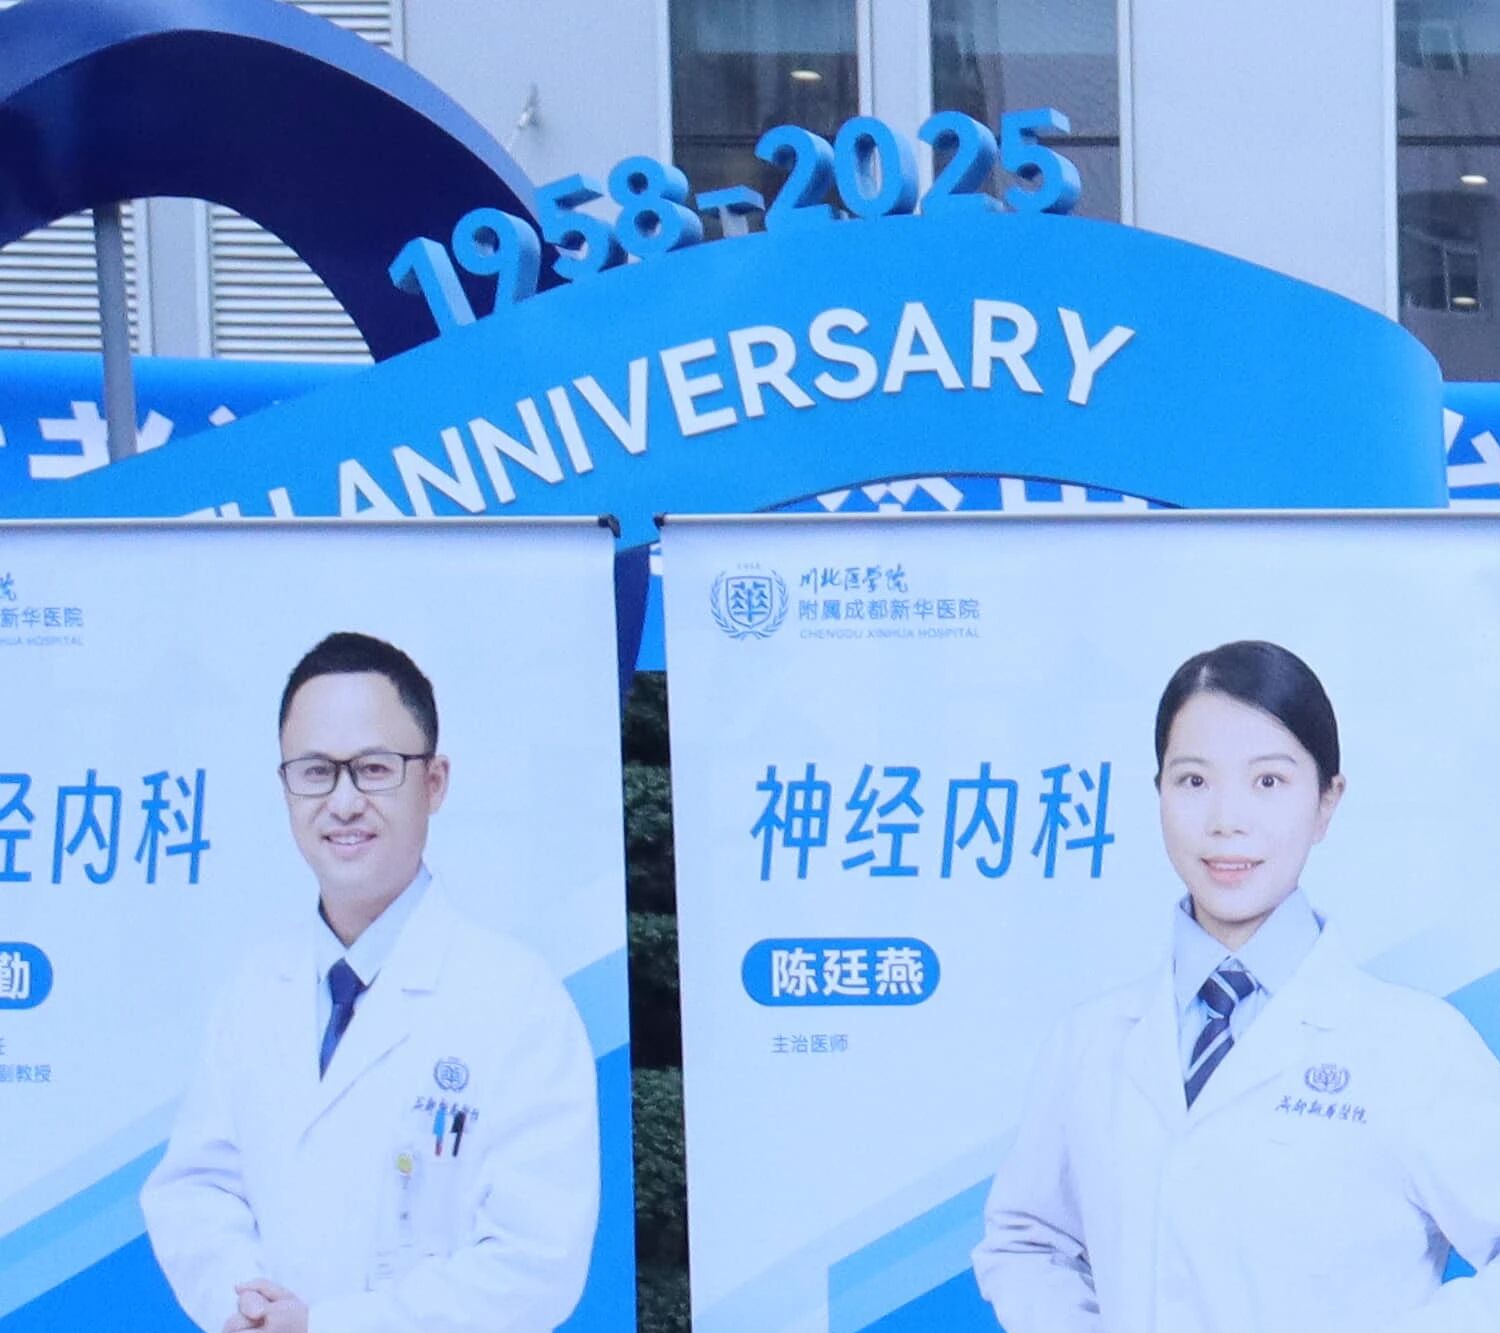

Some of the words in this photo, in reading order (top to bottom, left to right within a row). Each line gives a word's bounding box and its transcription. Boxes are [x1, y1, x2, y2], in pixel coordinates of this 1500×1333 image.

[390, 106, 1081, 332] 1958-2025
[338, 297, 1135, 516] ANNIVERSARY
[799, 598, 980, 621] 附属成都新华医院
[752, 760, 1117, 881] 神经内科
[769, 949, 925, 999] 陈廷燕
[771, 1034, 849, 1055] 主治医师
